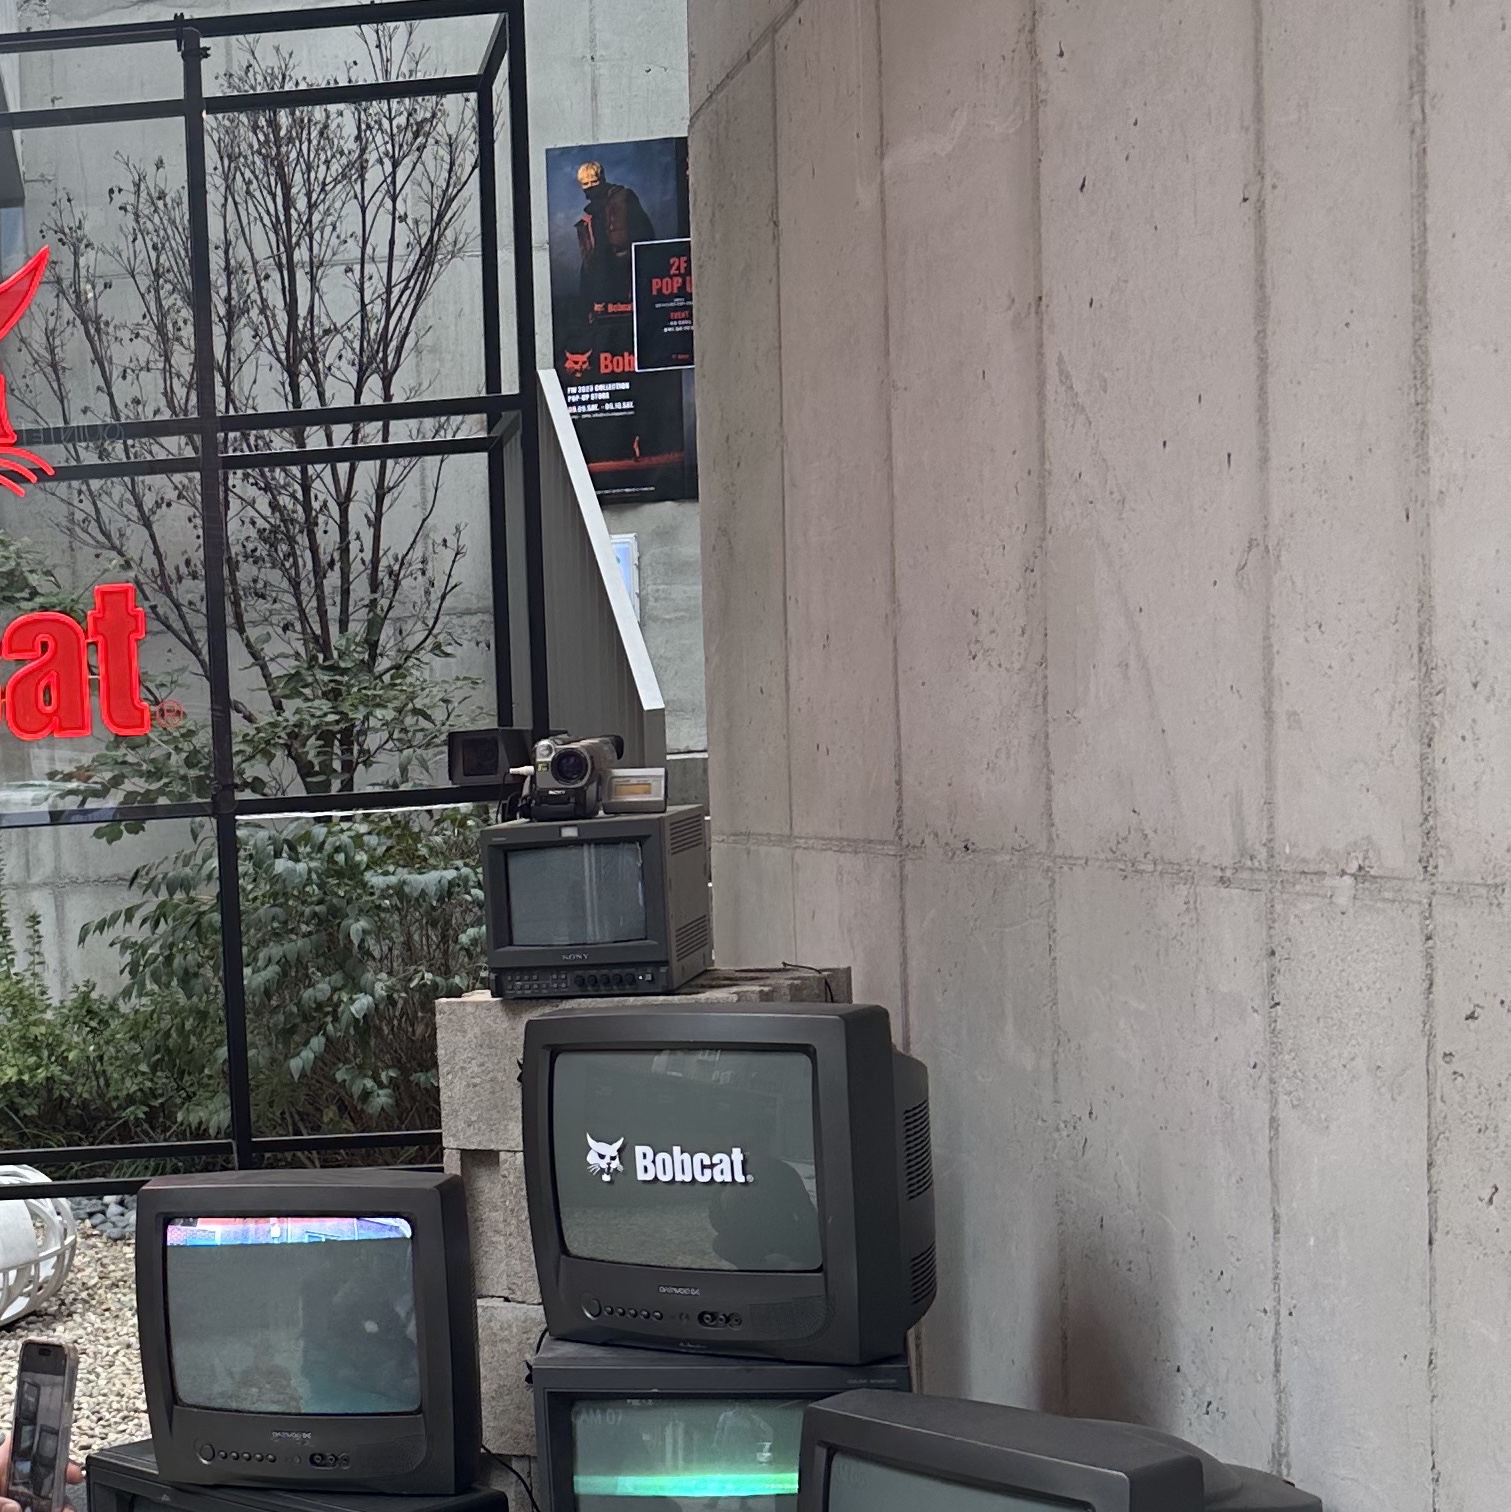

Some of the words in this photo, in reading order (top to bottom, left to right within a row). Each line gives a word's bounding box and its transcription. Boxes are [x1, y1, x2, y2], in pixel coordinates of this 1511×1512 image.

[670, 256, 688, 275] 2F
[651, 277, 683, 296] POP
[599, 351, 635, 374] Bob
[594, 381, 630, 391] COLLECTION
[567, 394, 590, 402] POP-UP
[634, 1145, 746, 1183] Bobcat
